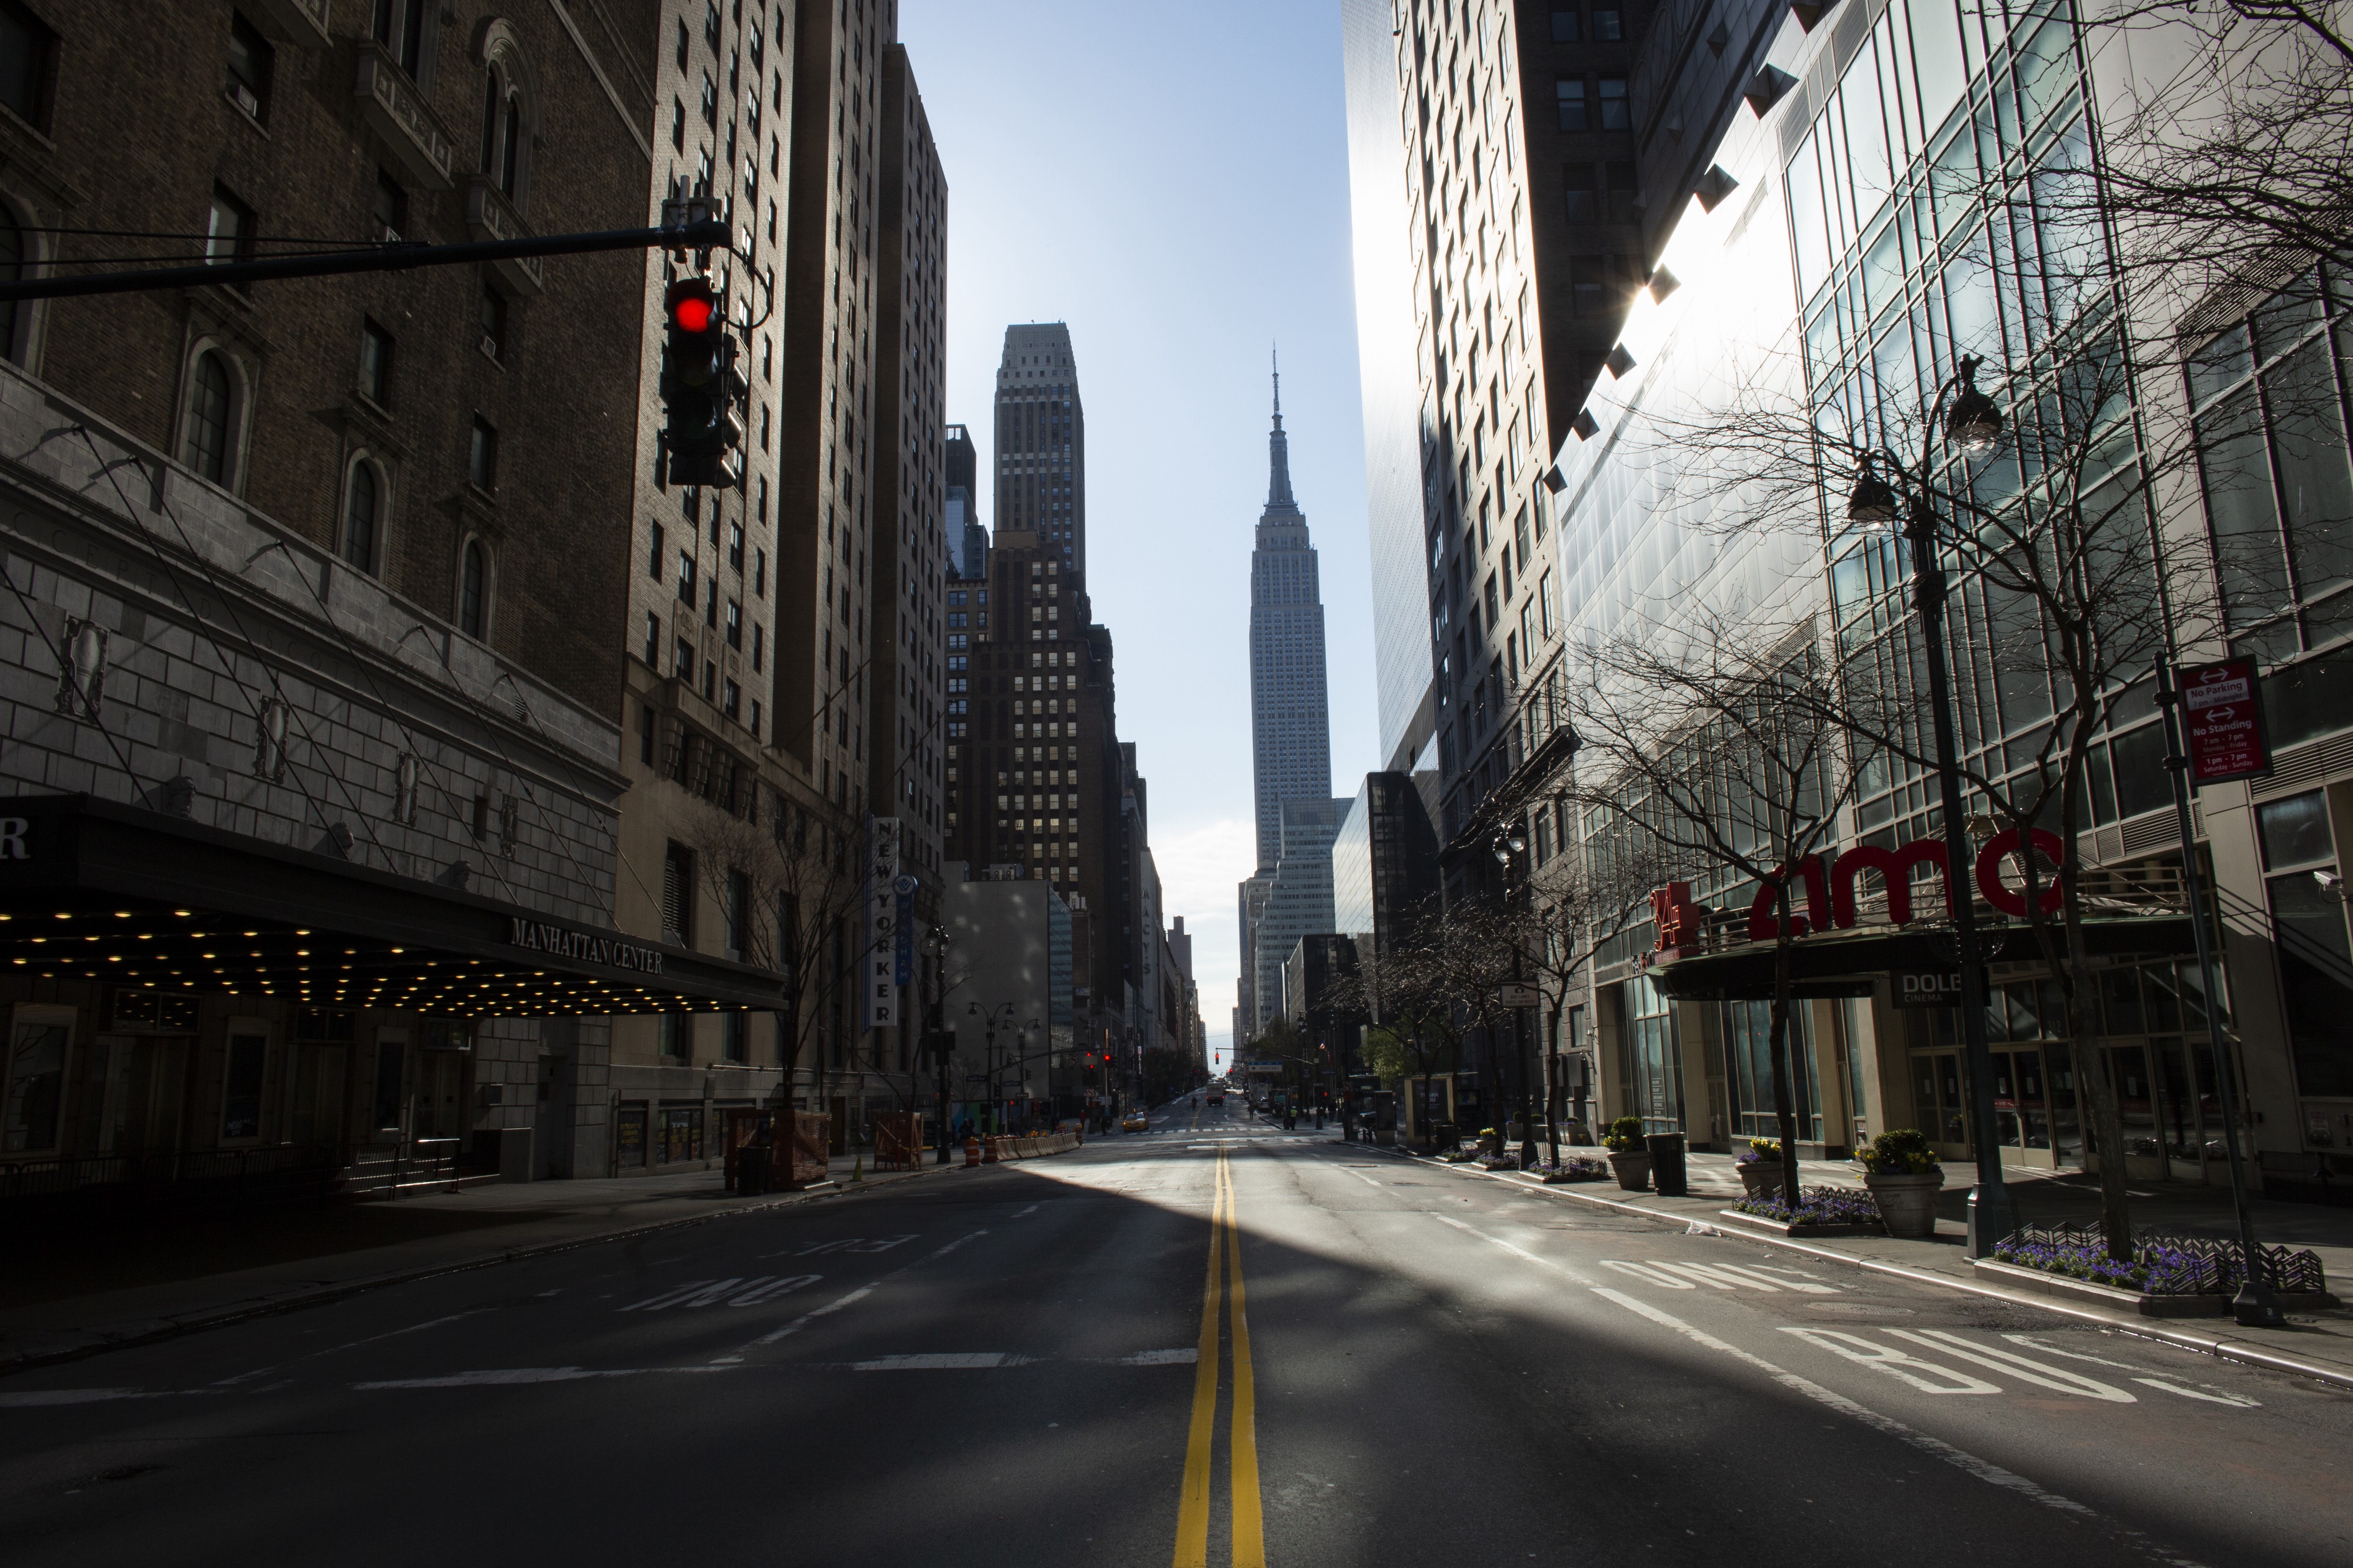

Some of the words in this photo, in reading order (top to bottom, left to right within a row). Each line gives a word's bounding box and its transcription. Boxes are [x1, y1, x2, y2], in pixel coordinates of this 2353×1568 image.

[2191, 690, 2204, 698] No
[2206, 682, 2242, 695] Parking
[2214, 693, 2243, 703] Midnight
[2193, 728, 2207, 736] No
[2208, 720, 2252, 733] Standing
[2234, 733, 2244, 742] pm
[2237, 753, 2247, 761] pm
[2204, 765, 2228, 773] Saturday
[876, 823, 893, 879] NEW
[1749, 827, 2064, 941] amc
[510, 917, 609, 963] MANHATTAN
[613, 942, 663, 975] CENTER
[900, 902, 909, 979] WYNDHAM
[876, 895, 891, 1020] YORKER
[1655, 951, 1678, 965] STREET
[1902, 973, 1961, 992] DOLB
[1905, 994, 1944, 1002] CINEMA
[1775, 1326, 2264, 1408] BUS
